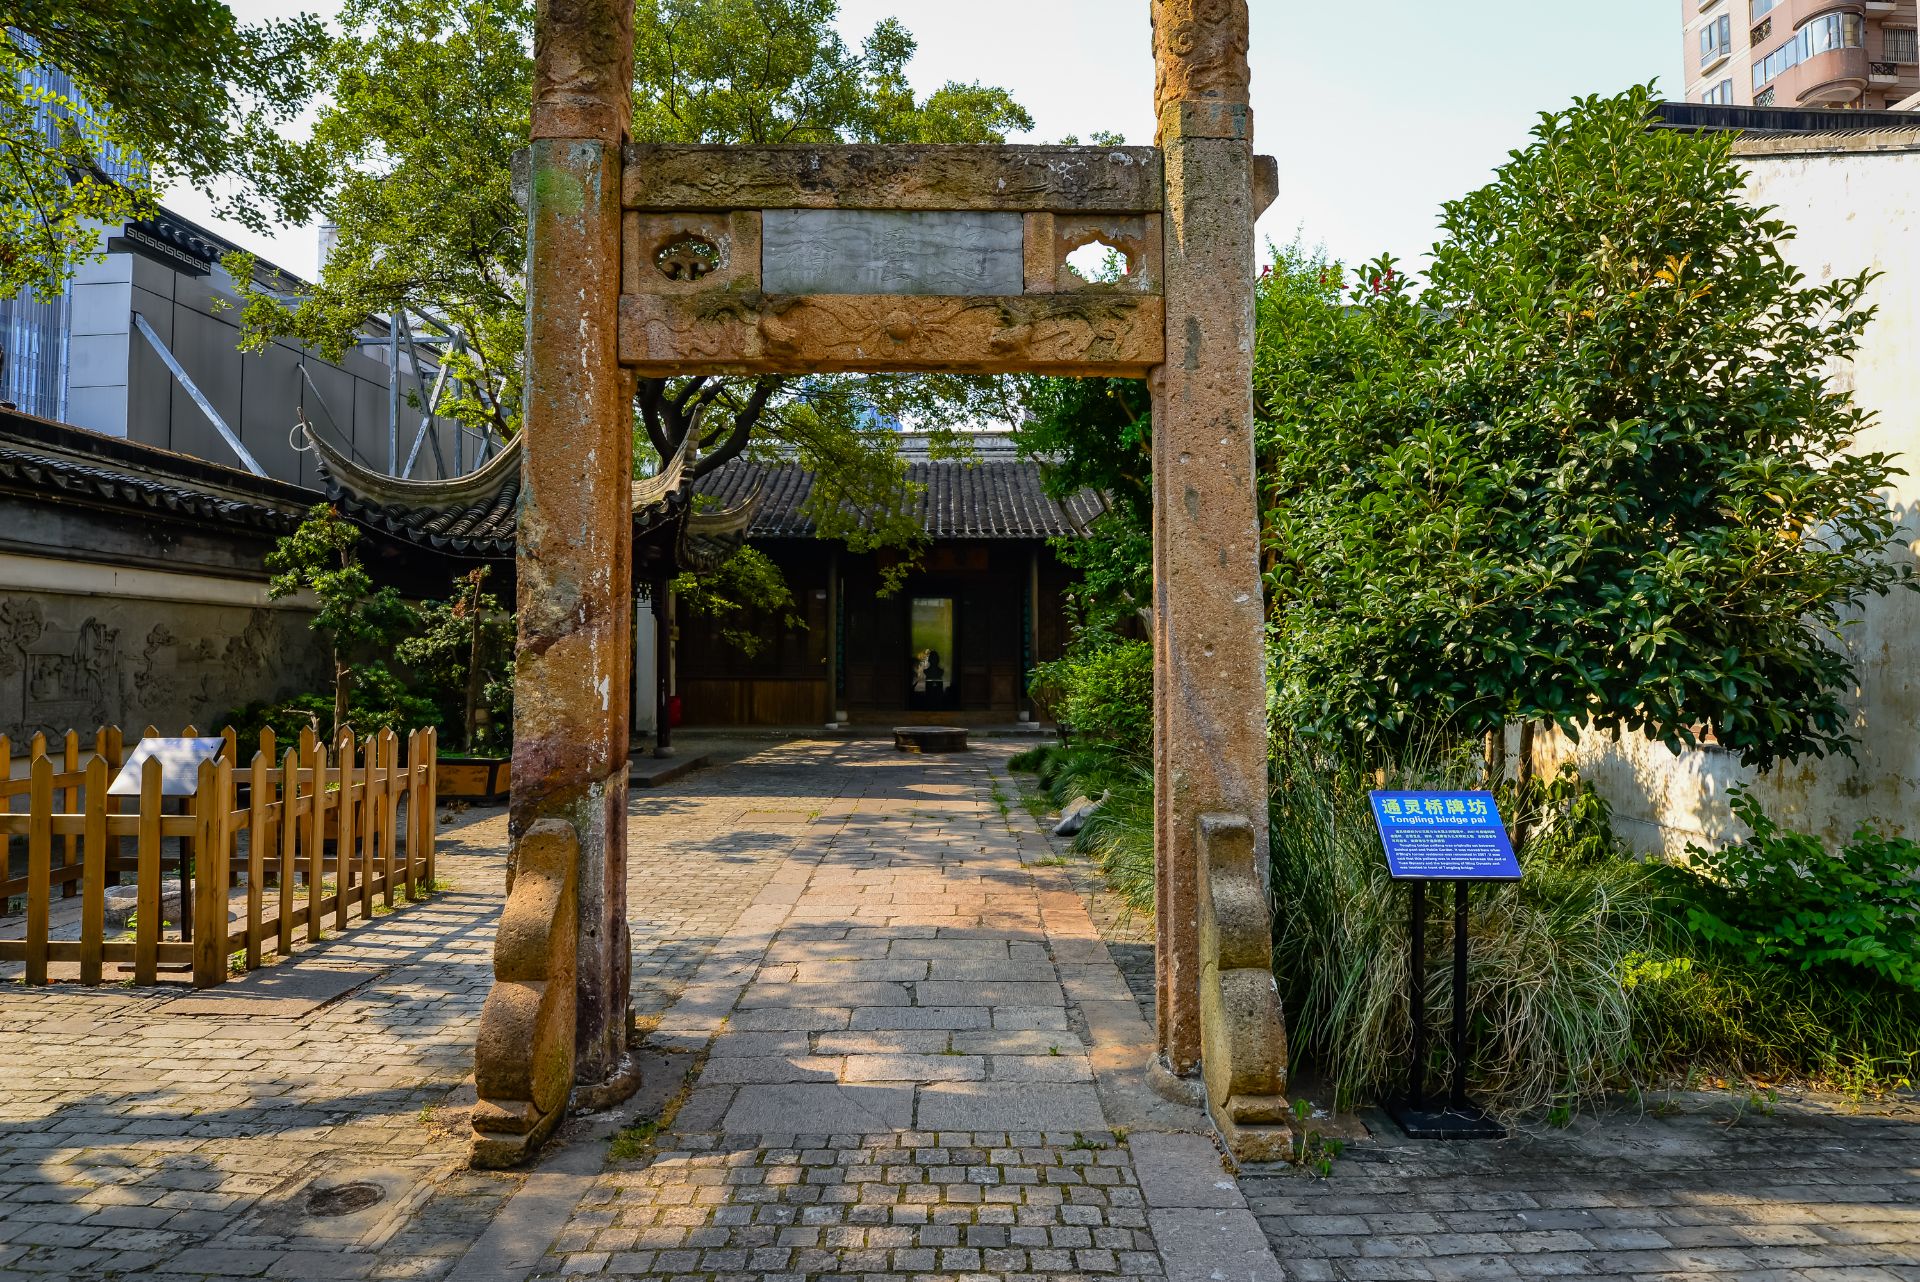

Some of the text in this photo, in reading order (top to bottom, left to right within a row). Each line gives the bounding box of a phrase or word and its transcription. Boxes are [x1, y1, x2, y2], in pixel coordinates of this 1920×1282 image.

[1382, 799, 1488, 815] 通灵桥牌坊
[1390, 815, 1487, 824] Tongling birdge pai
